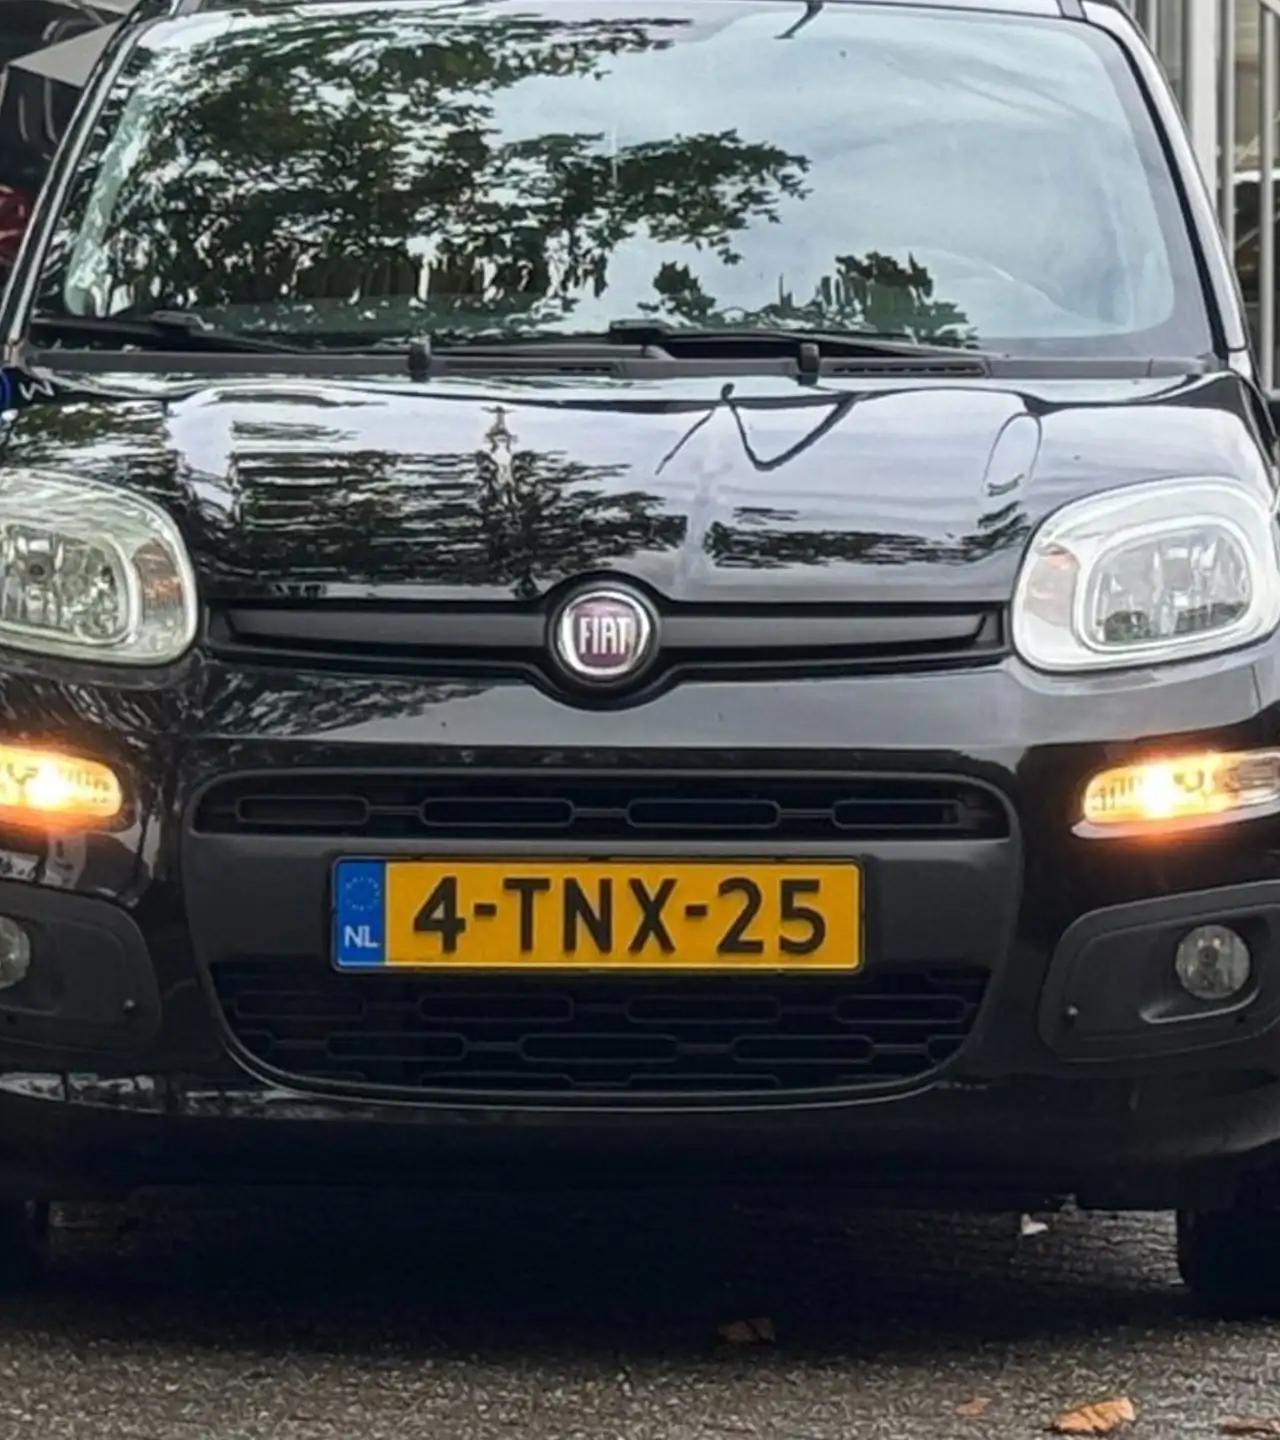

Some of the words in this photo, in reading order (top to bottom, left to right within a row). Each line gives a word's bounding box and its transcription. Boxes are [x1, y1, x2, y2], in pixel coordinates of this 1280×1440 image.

[579, 616, 631, 655] FIAT
[413, 876, 827, 955] 4-TNX-25
[344, 926, 378, 948] NL
